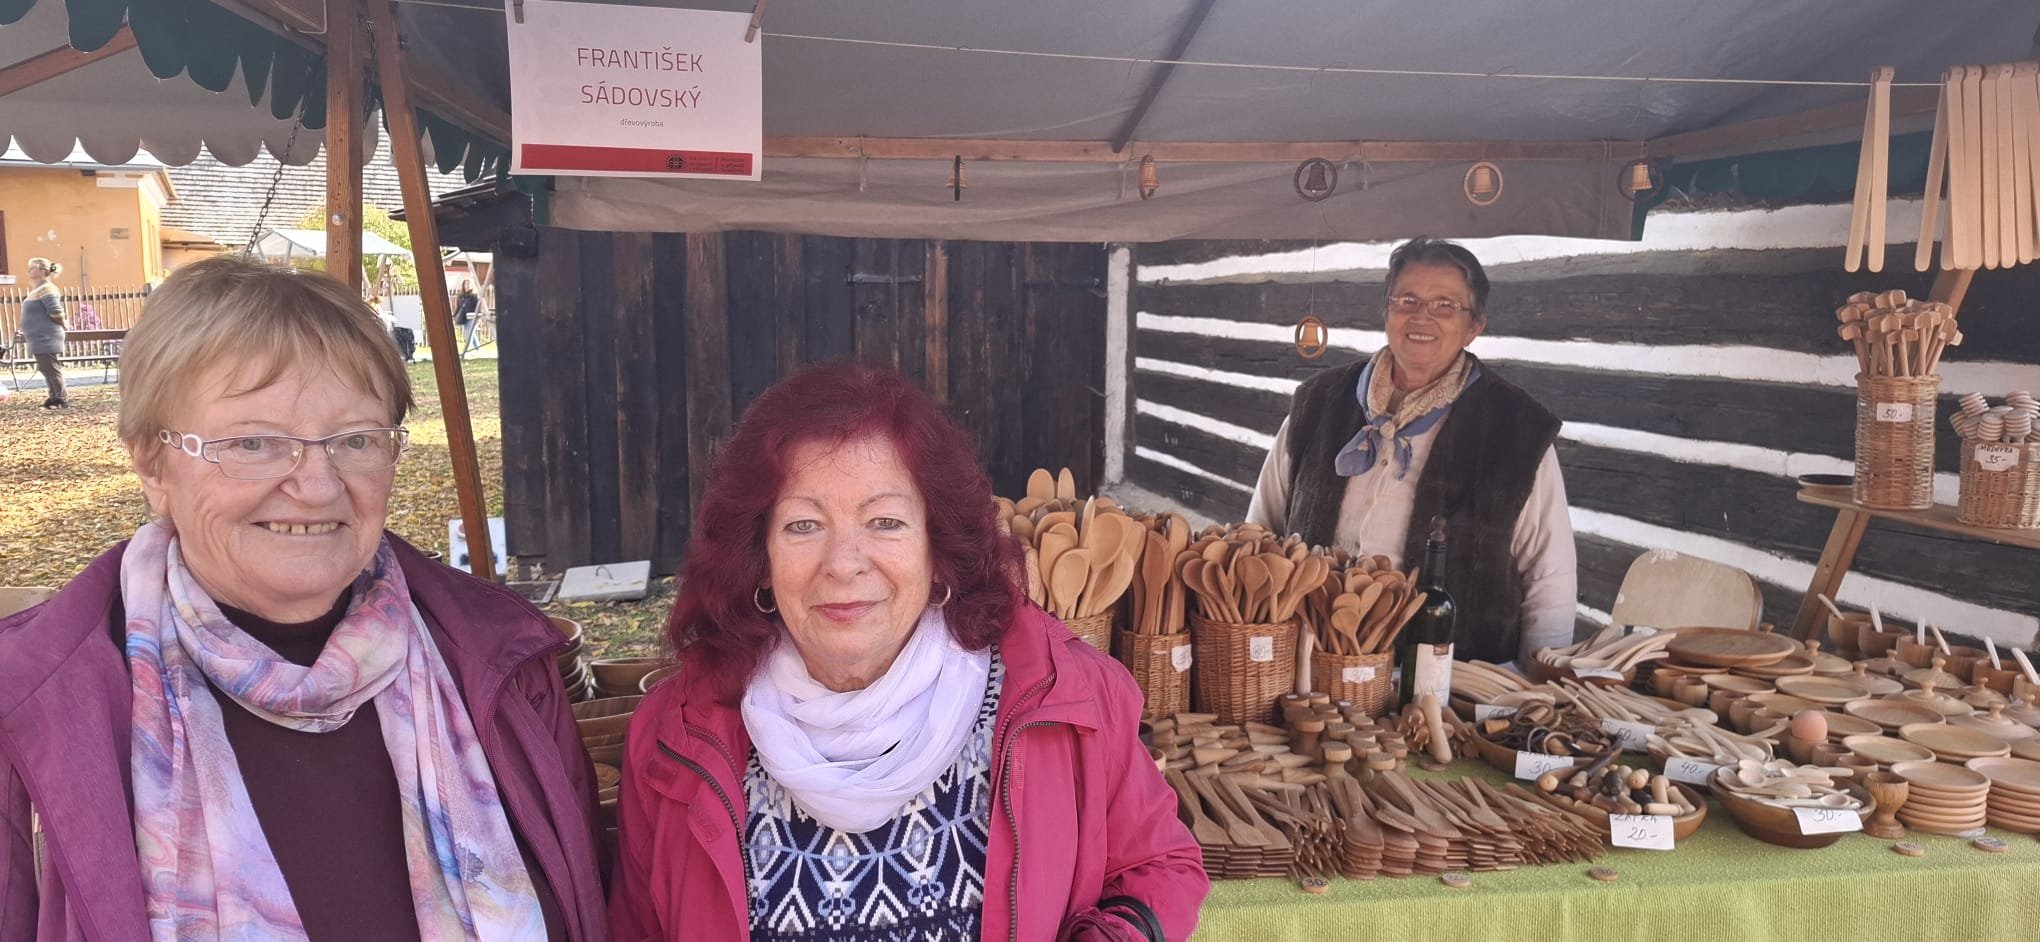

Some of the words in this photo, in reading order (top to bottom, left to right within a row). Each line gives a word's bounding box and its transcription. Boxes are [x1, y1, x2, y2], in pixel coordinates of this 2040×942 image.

[577, 46, 704, 73] FRANTIŠEK
[581, 80, 702, 109] SÁDOVSKÝ
[619, 118, 664, 128] dřevovýroba
